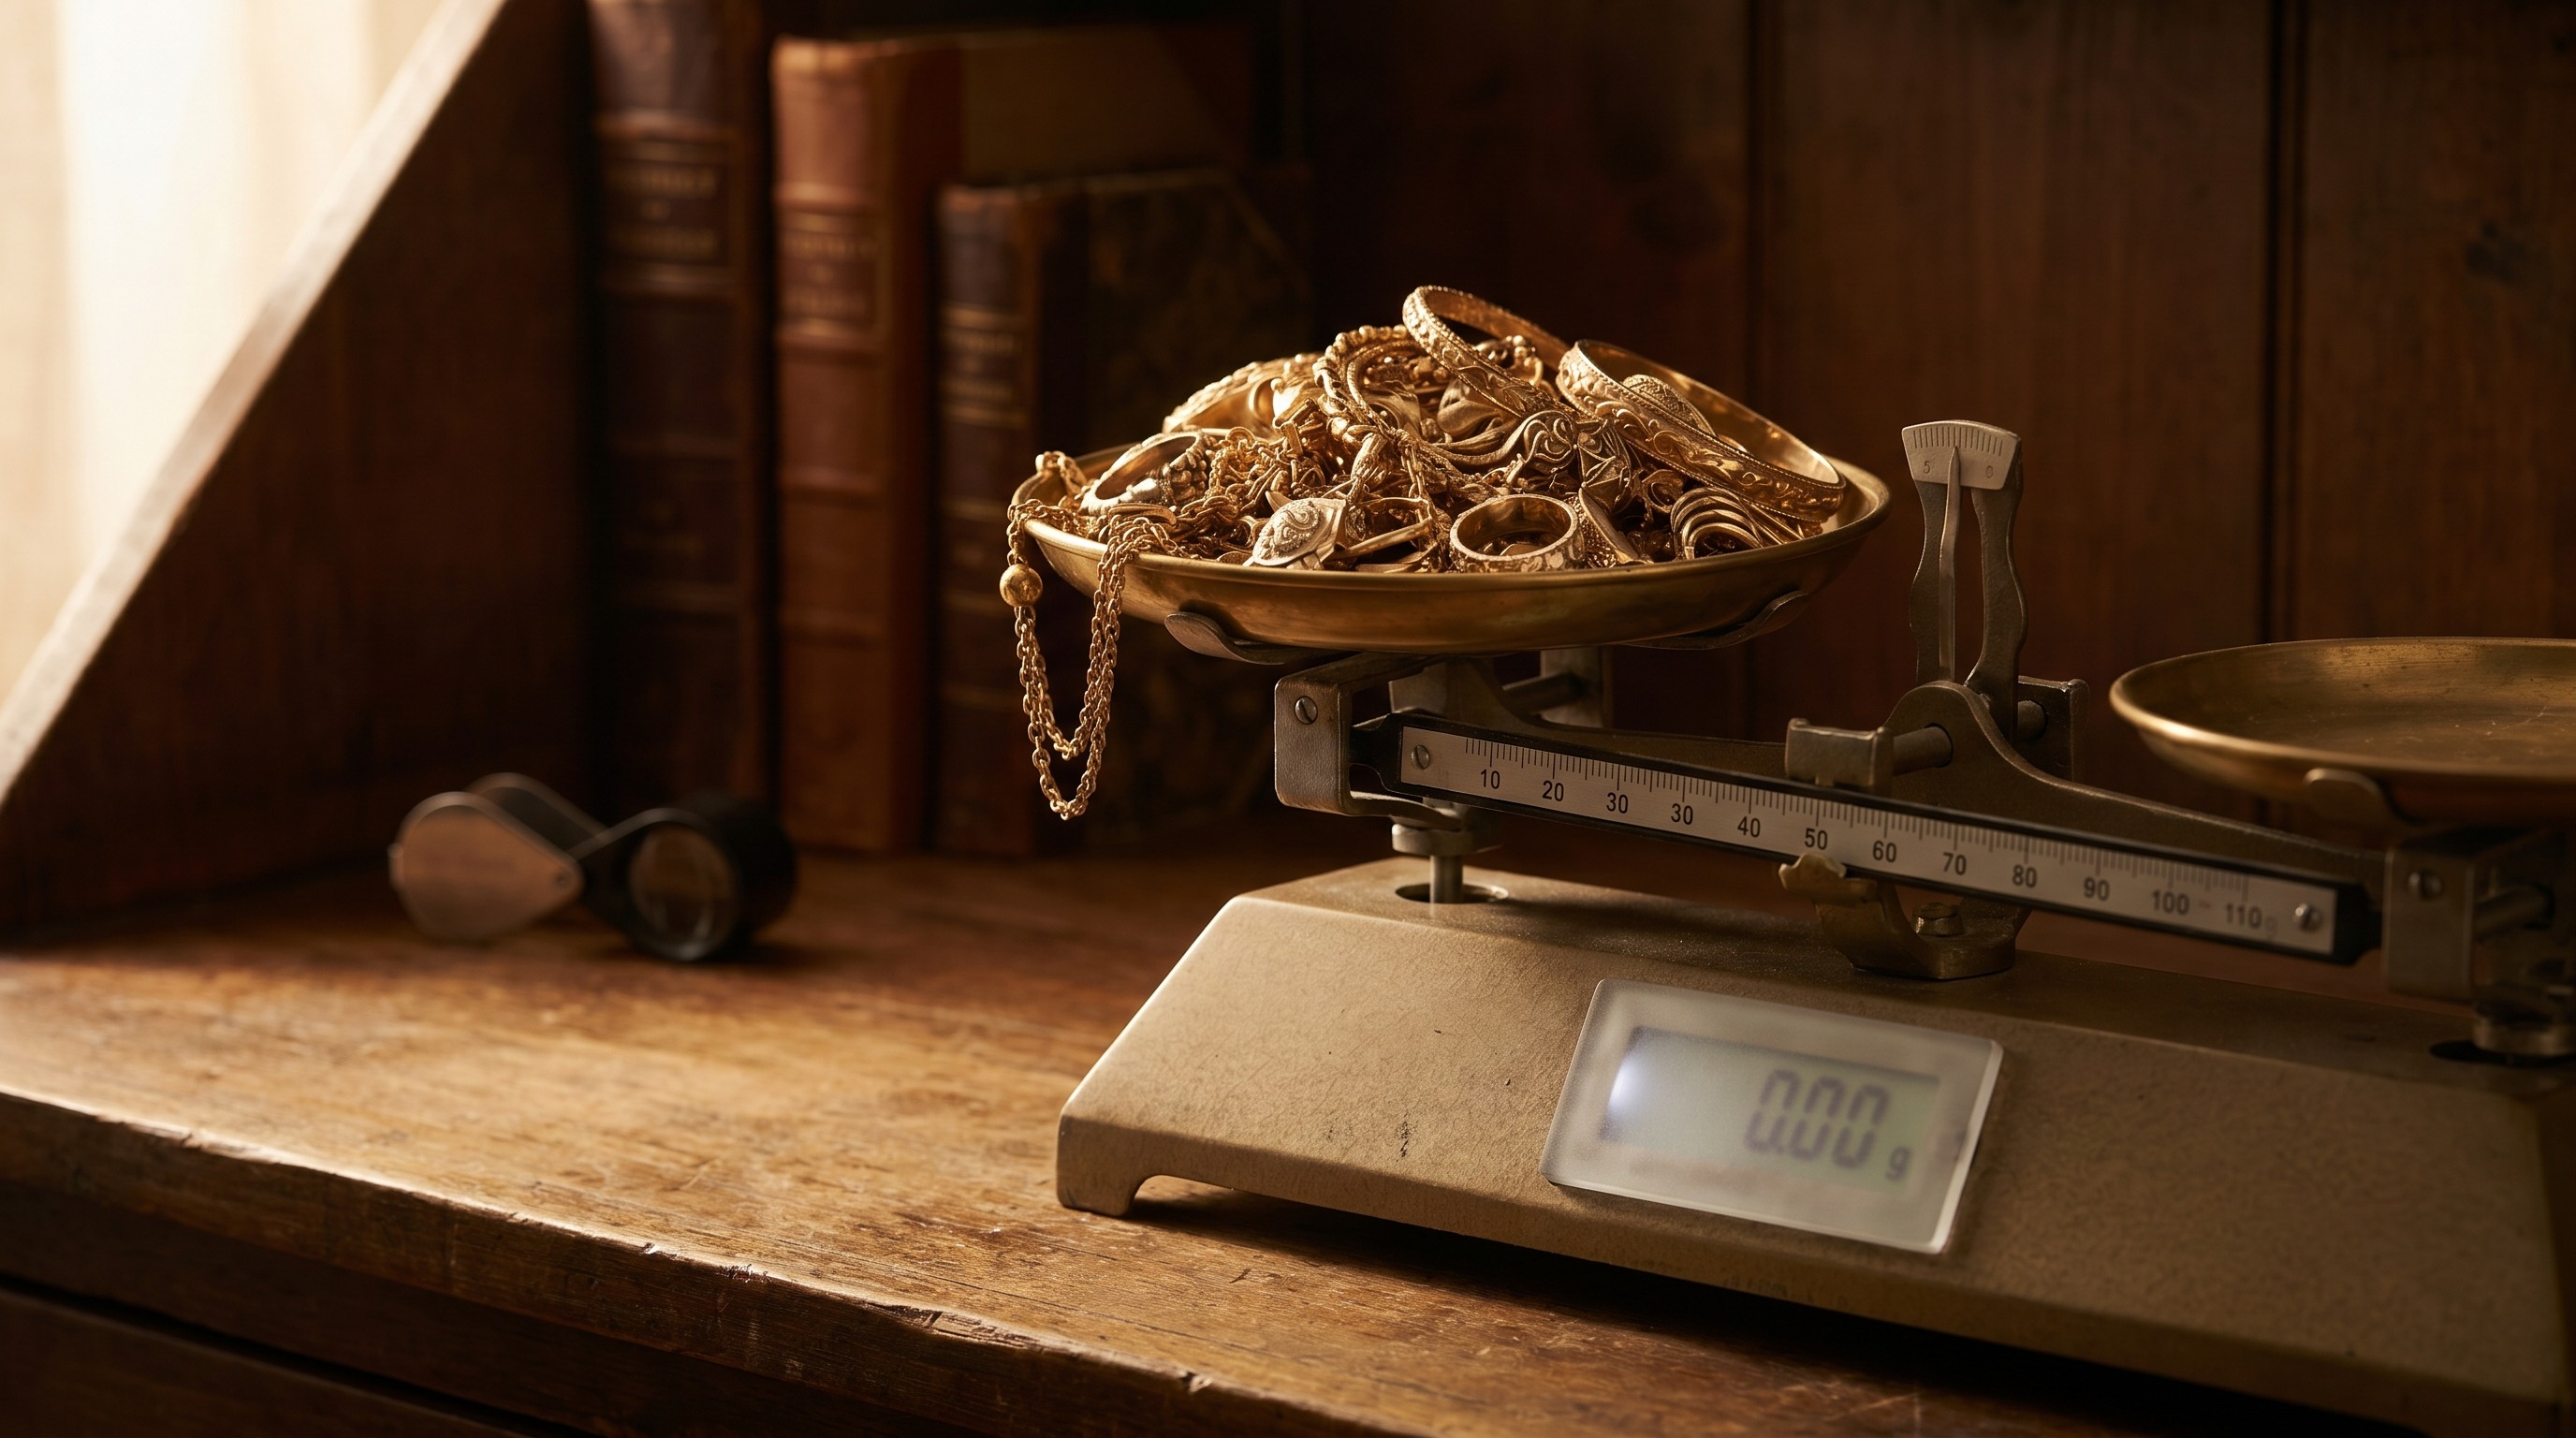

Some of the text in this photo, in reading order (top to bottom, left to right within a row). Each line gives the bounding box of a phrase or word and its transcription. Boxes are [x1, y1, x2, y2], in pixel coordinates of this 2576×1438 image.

[1923, 461, 1930, 474] 5
[1480, 769, 1500, 789] 10
[1542, 780, 1564, 802] 20
[1606, 792, 1629, 814] 30
[1671, 803, 1693, 826] 30
[1737, 816, 1761, 838] 40
[1805, 828, 1827, 851] 50
[1872, 841, 1897, 863] 60
[1942, 852, 1967, 875] 70
[2012, 864, 2037, 888] 80
[2083, 877, 2110, 902] 90
[2151, 889, 2190, 915] 100
[2225, 902, 2262, 929] 110
[1745, 1069, 1912, 1181] 0.00 g
